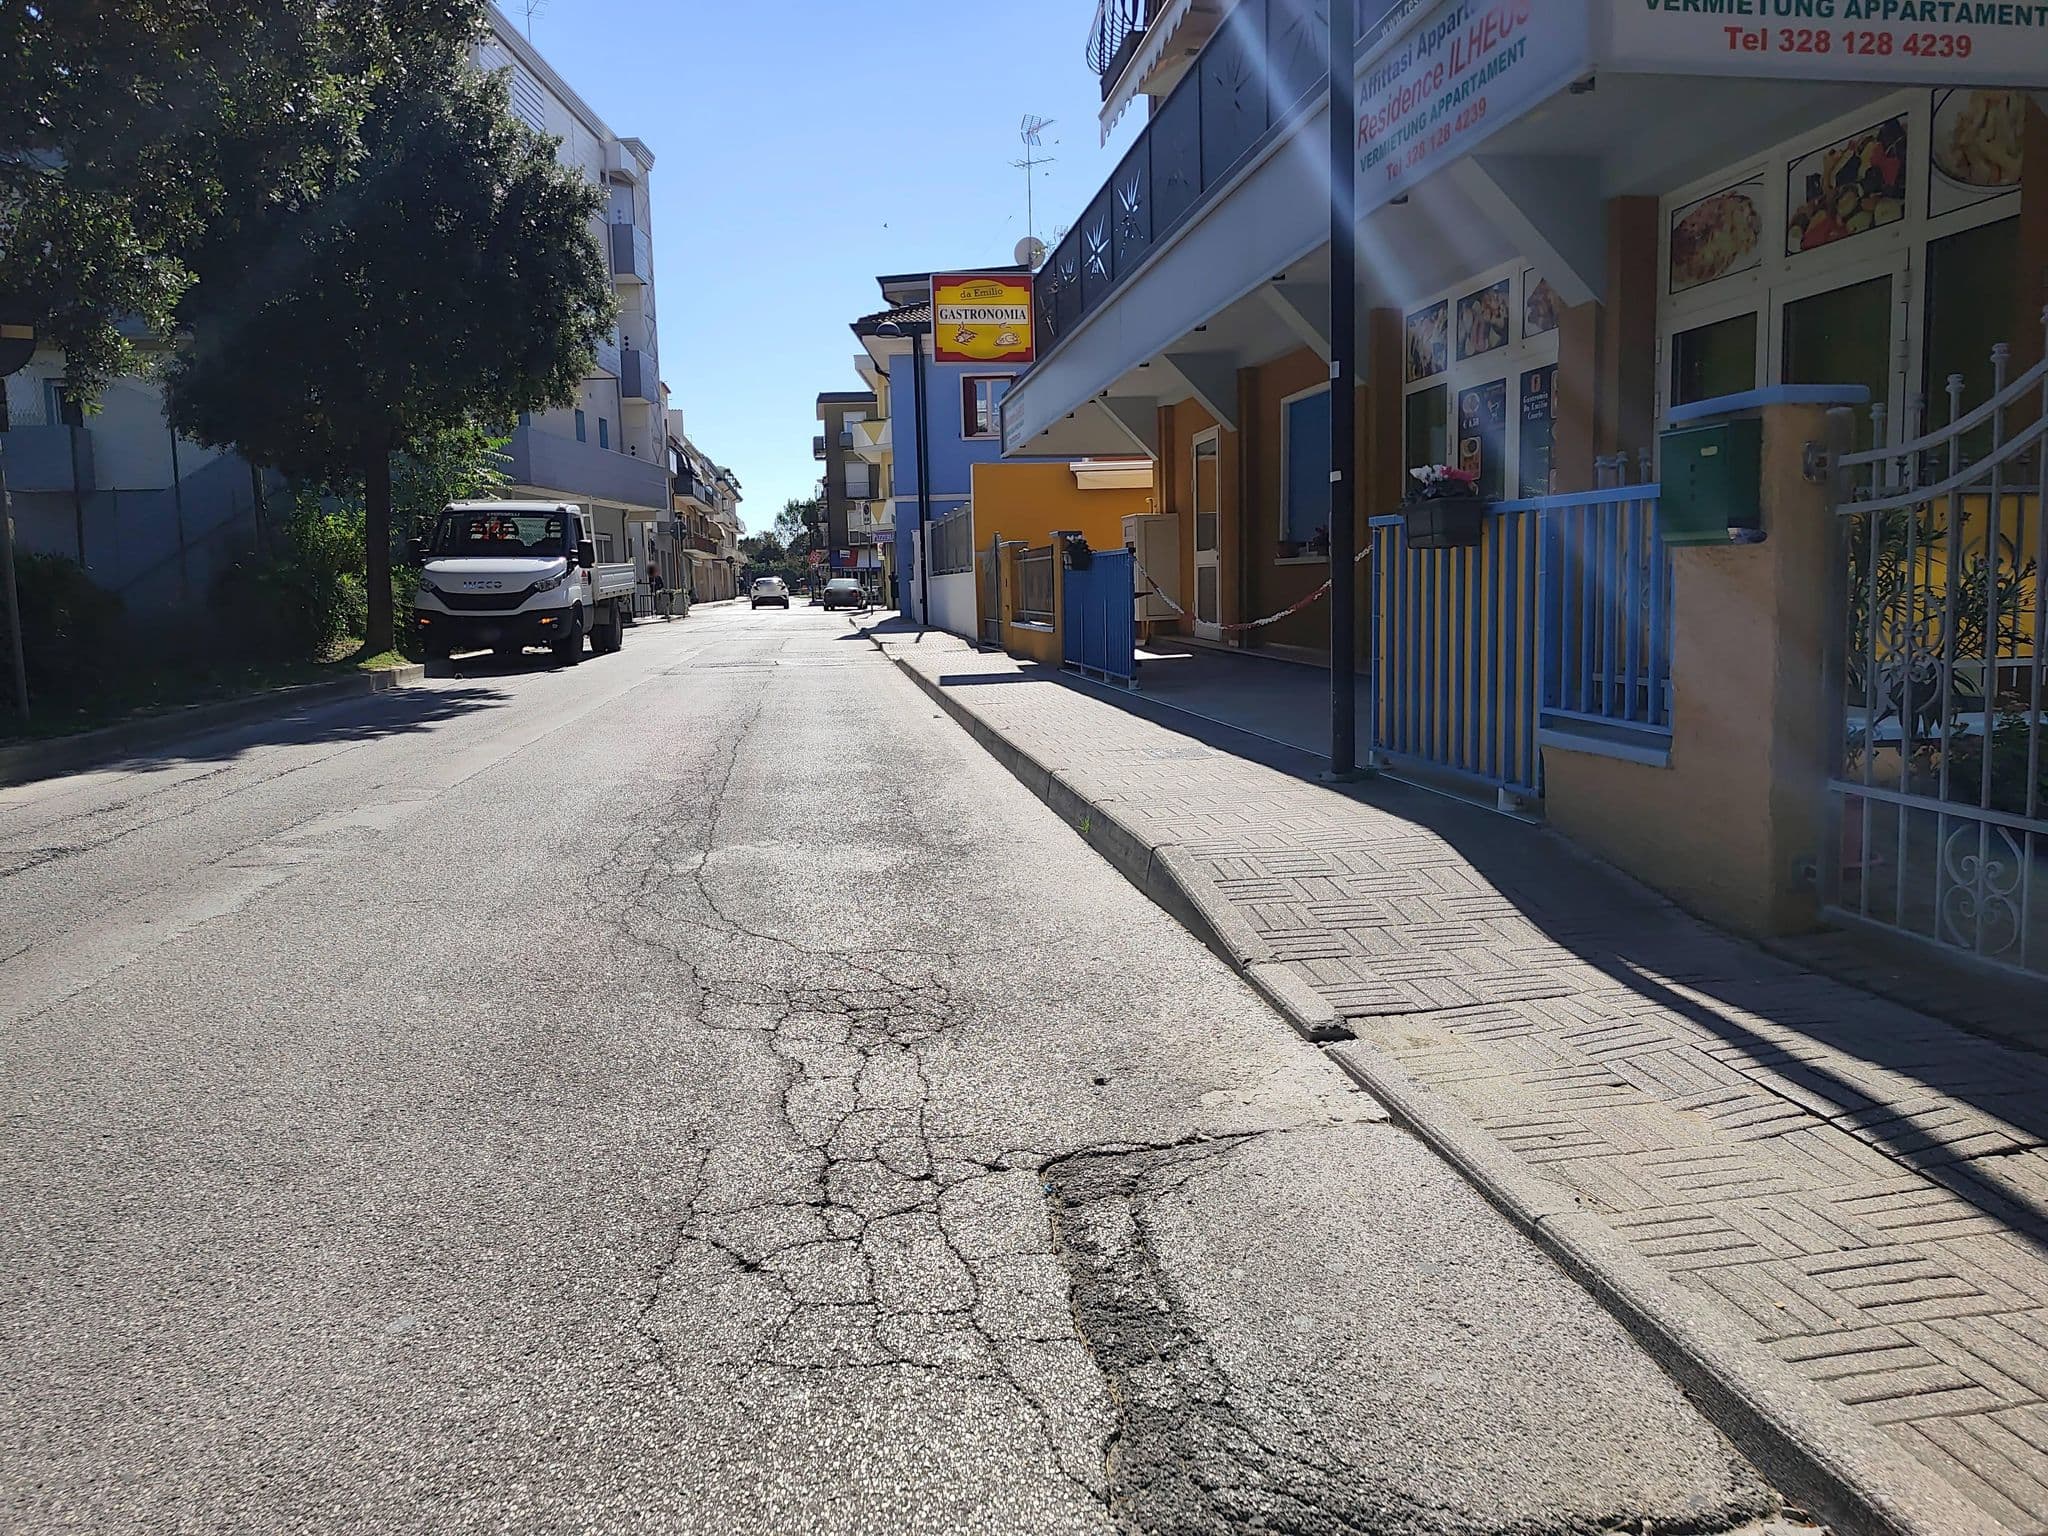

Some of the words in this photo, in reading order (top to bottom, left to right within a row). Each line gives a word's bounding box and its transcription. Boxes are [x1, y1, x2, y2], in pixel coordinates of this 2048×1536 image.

[1645, 0, 1834, 18] VERMIETUNG
[1844, 0, 2048, 27] APPARTAMENT
[1724, 26, 1767, 51] Tel
[1778, 28, 1831, 54] 328
[1842, 31, 1893, 56] 128
[1903, 33, 1972, 59] 4239
[1360, 44, 1412, 106] Affittasi
[1357, 62, 1444, 149] Residence
[1360, 112, 1427, 172] VERMIETUNG
[1430, 36, 1527, 122] APPARTAMENT
[1386, 159, 1402, 181] Tel
[1406, 142, 1425, 169] 328
[1430, 123, 1451, 150] 128
[1455, 96, 1487, 132] 4239
[960, 290, 971, 299] da
[974, 288, 1003, 297] Emilio
[940, 308, 1027, 320] GASTRONOMIA
[463, 581, 502, 589] IVECO
